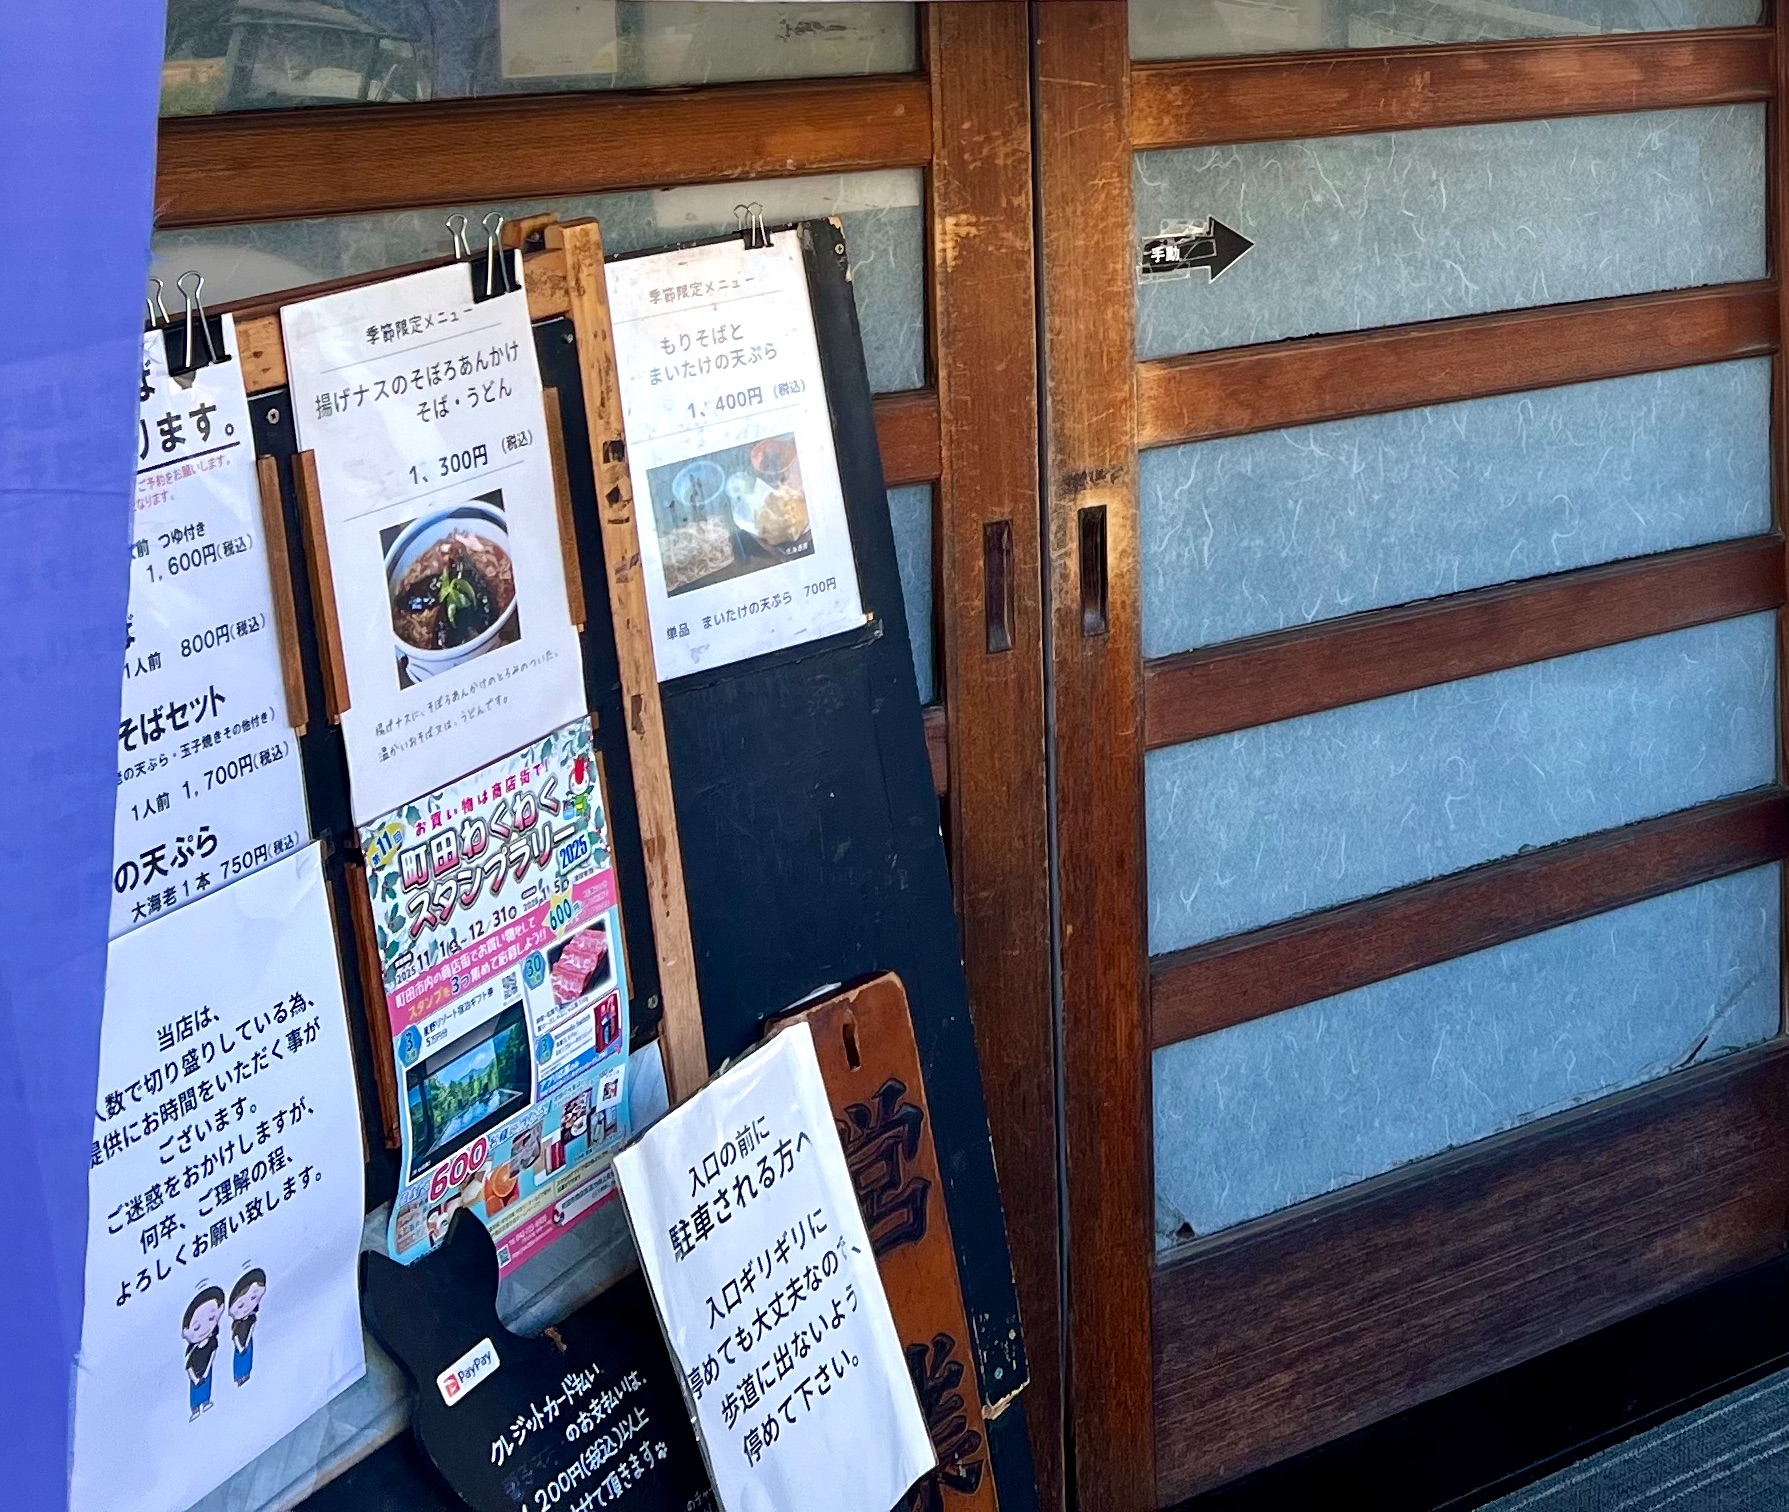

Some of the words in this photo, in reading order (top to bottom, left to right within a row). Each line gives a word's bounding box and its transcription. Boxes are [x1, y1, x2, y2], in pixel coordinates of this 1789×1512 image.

[1150, 245, 1181, 263] 手動
[648, 276, 756, 306] 季節限定メニュー
[364, 307, 474, 346] 季節限定メニュー
[660, 323, 745, 356] もりそばと
[314, 340, 520, 420] 揚げナスのそぼろあんかけ
[649, 342, 778, 386] まいたけの天ぷら
[416, 377, 513, 423] そば・うどん
[158, 521, 206, 546] つゆ付き
[666, 621, 691, 641] 単品
[701, 590, 793, 630] まいたけの天ぷら
[803, 576, 838, 598] 700円
[118, 684, 227, 752] そばセット
[131, 791, 171, 822] 1人前
[399, 773, 561, 891] 町田わくわく
[114, 825, 218, 894] の天ぷら
[559, 833, 588, 869] 2025
[155, 1004, 221, 1053] 当店は、
[158, 1095, 258, 1165] ございます。
[687, 1115, 771, 1198] 入口の前に
[106, 1095, 316, 1236] ご迷惑をおかけしますが、
[428, 1135, 490, 1204] 600
[667, 1130, 813, 1262] 駐車される方へ
[139, 1145, 294, 1255] 何卒、ご理解の程、
[115, 1164, 323, 1308] よろしくお願い致します。
[704, 1206, 828, 1331] 入口ギリギリに
[456, 1349, 493, 1386] PayPay
[721, 1280, 859, 1431] 歩道に出ないよう
[741, 1348, 860, 1470] 停めて下さい。
